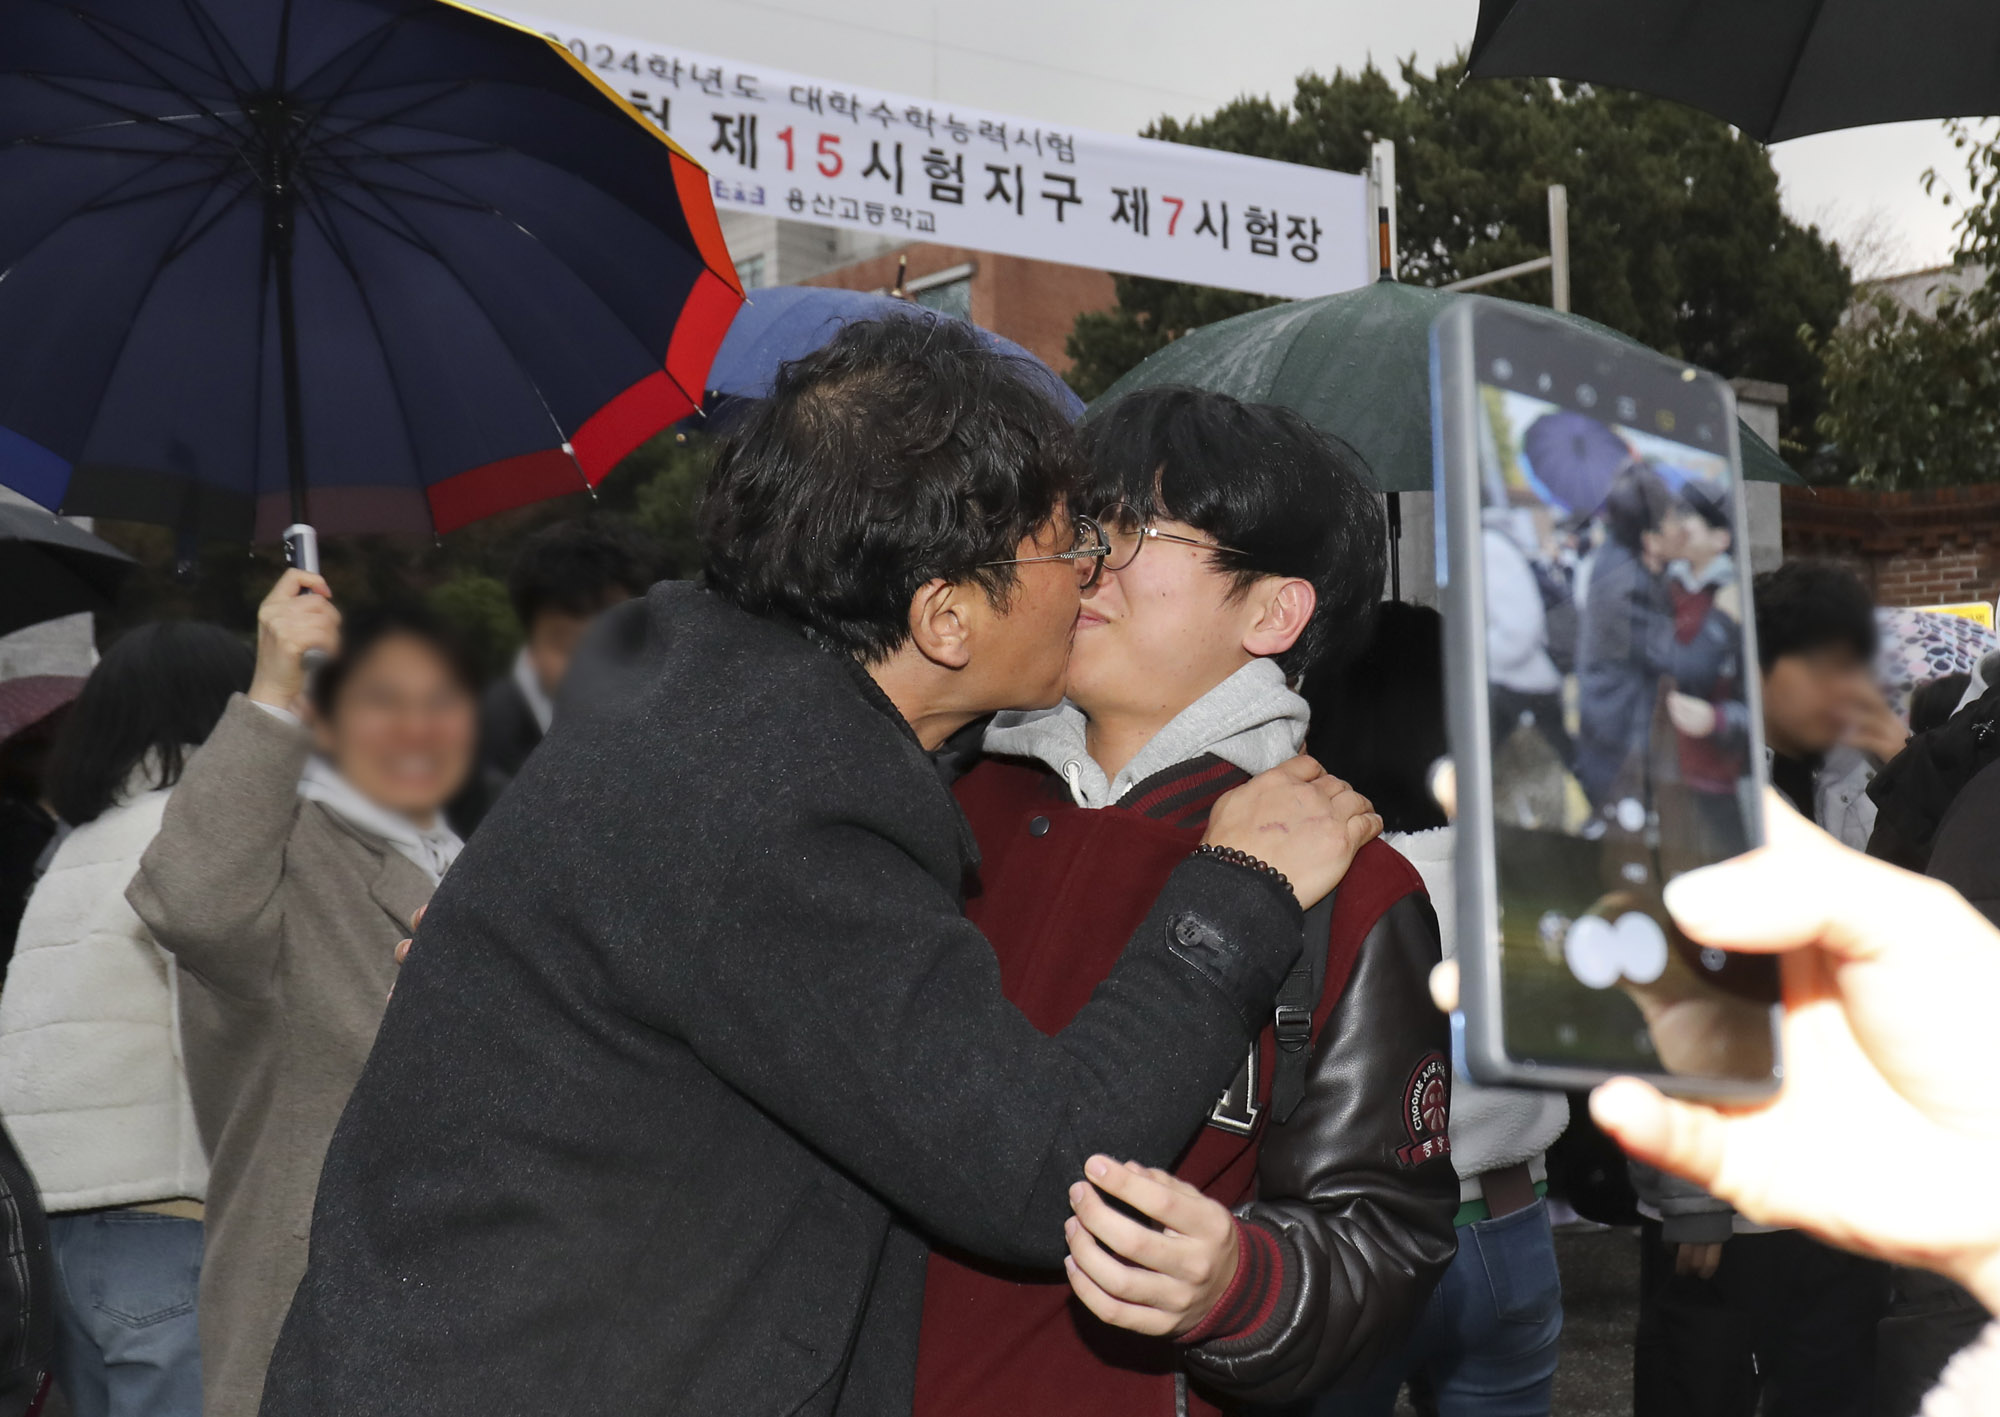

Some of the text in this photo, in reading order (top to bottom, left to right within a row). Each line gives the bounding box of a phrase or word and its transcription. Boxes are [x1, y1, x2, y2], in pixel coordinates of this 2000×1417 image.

[789, 86, 1076, 164] 대학수학능력시험
[711, 112, 1323, 263] 제15시험지구 제7시험장
[786, 187, 937, 233] 용산고등학교
